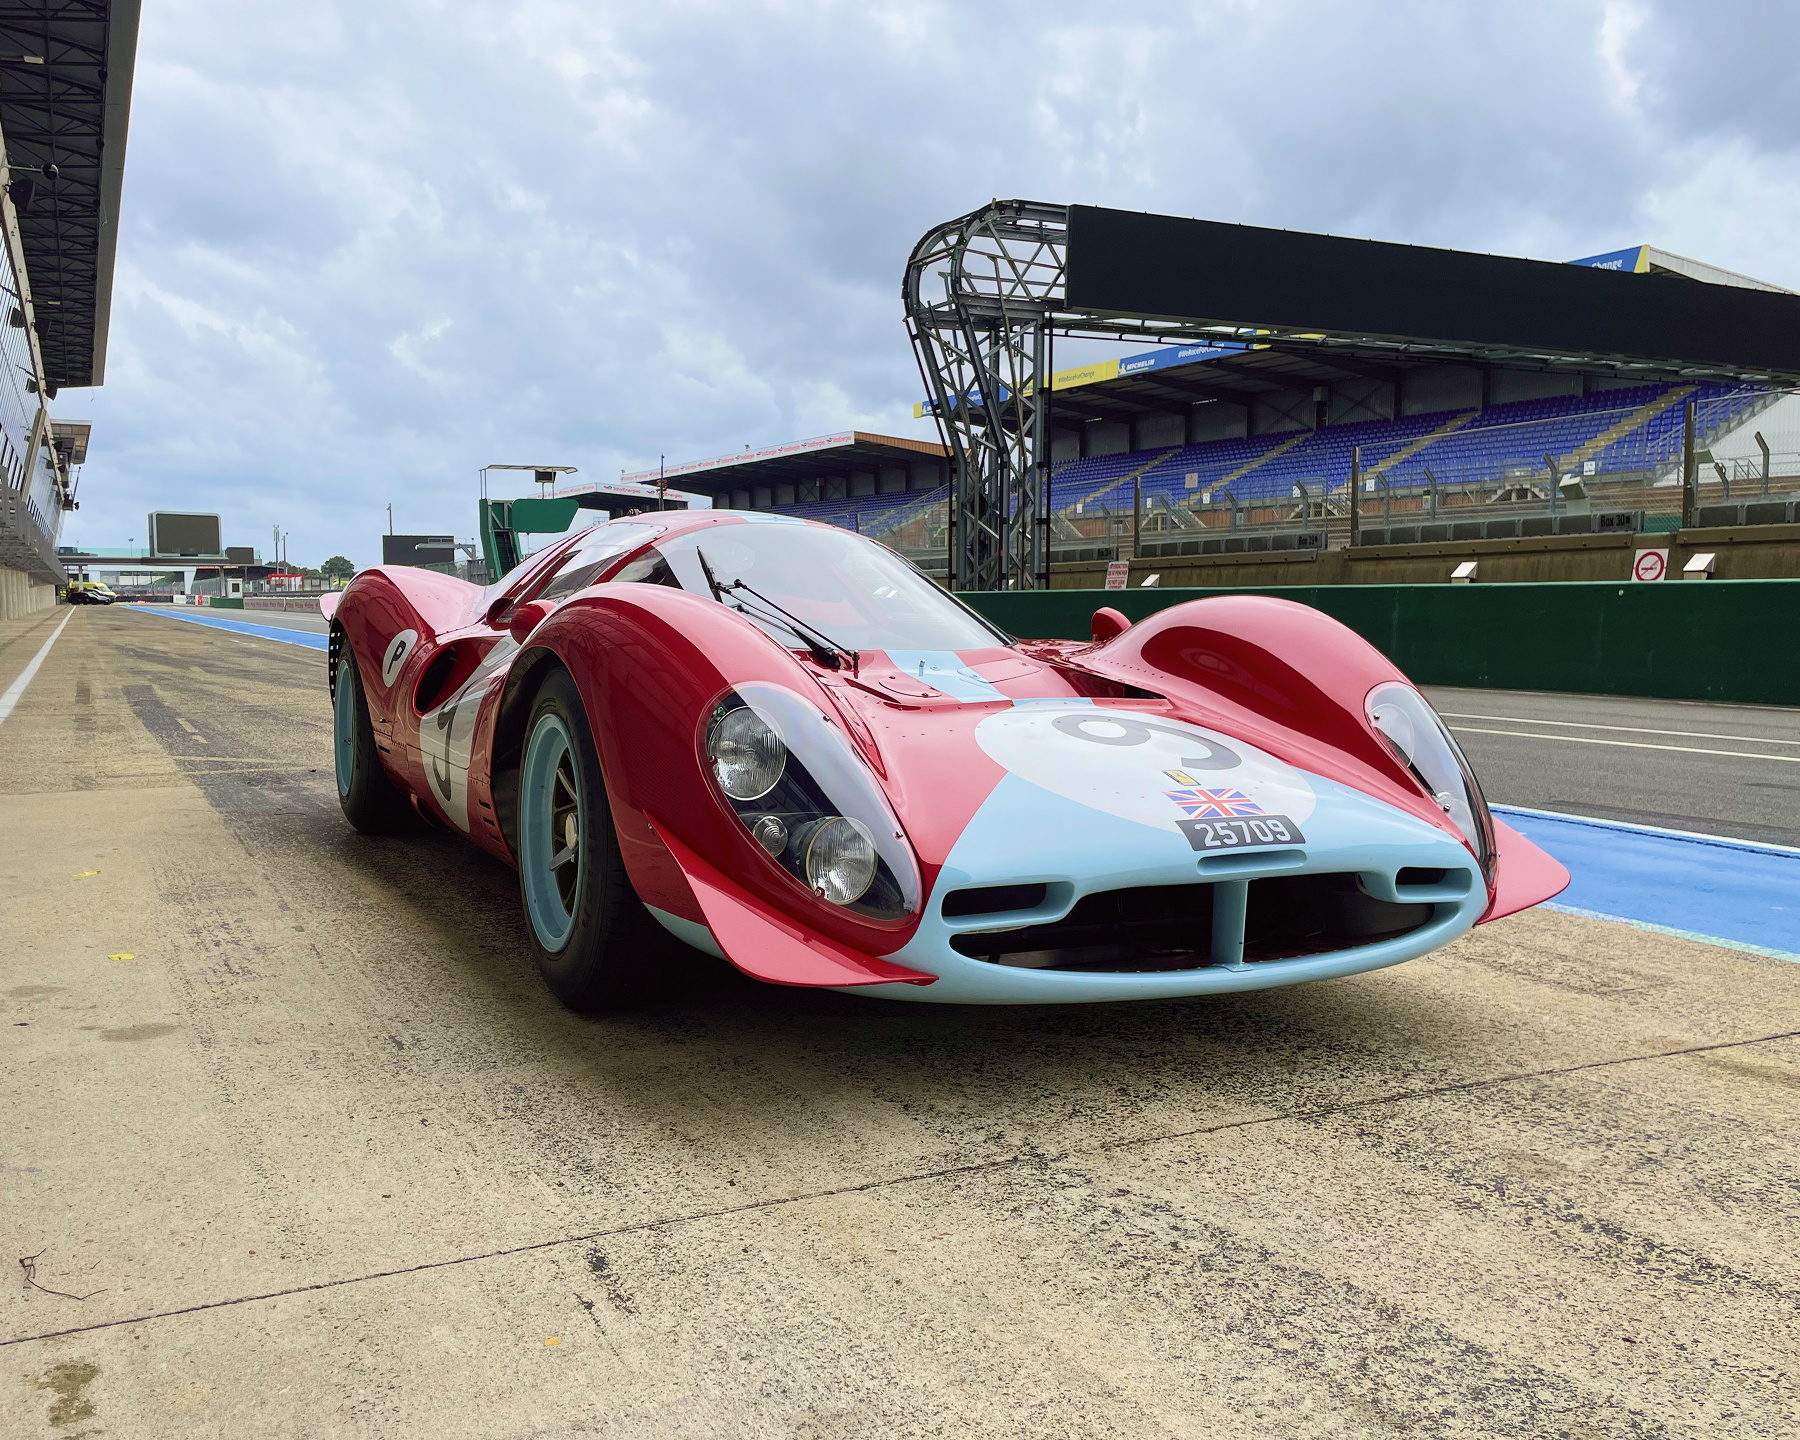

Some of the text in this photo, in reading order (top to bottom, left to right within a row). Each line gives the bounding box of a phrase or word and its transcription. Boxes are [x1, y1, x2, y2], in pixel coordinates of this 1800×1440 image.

[1126, 358, 1155, 371] MICHELIN
[1058, 371, 1095, 383] #WeRaceForChange
[613, 486, 641, 494] TotalEnergies
[1600, 515, 1614, 527] Box
[1615, 514, 1625, 526] 30
[386, 639, 407, 675] P
[1051, 714, 1243, 771] 9
[1193, 819, 1293, 848] 25709
